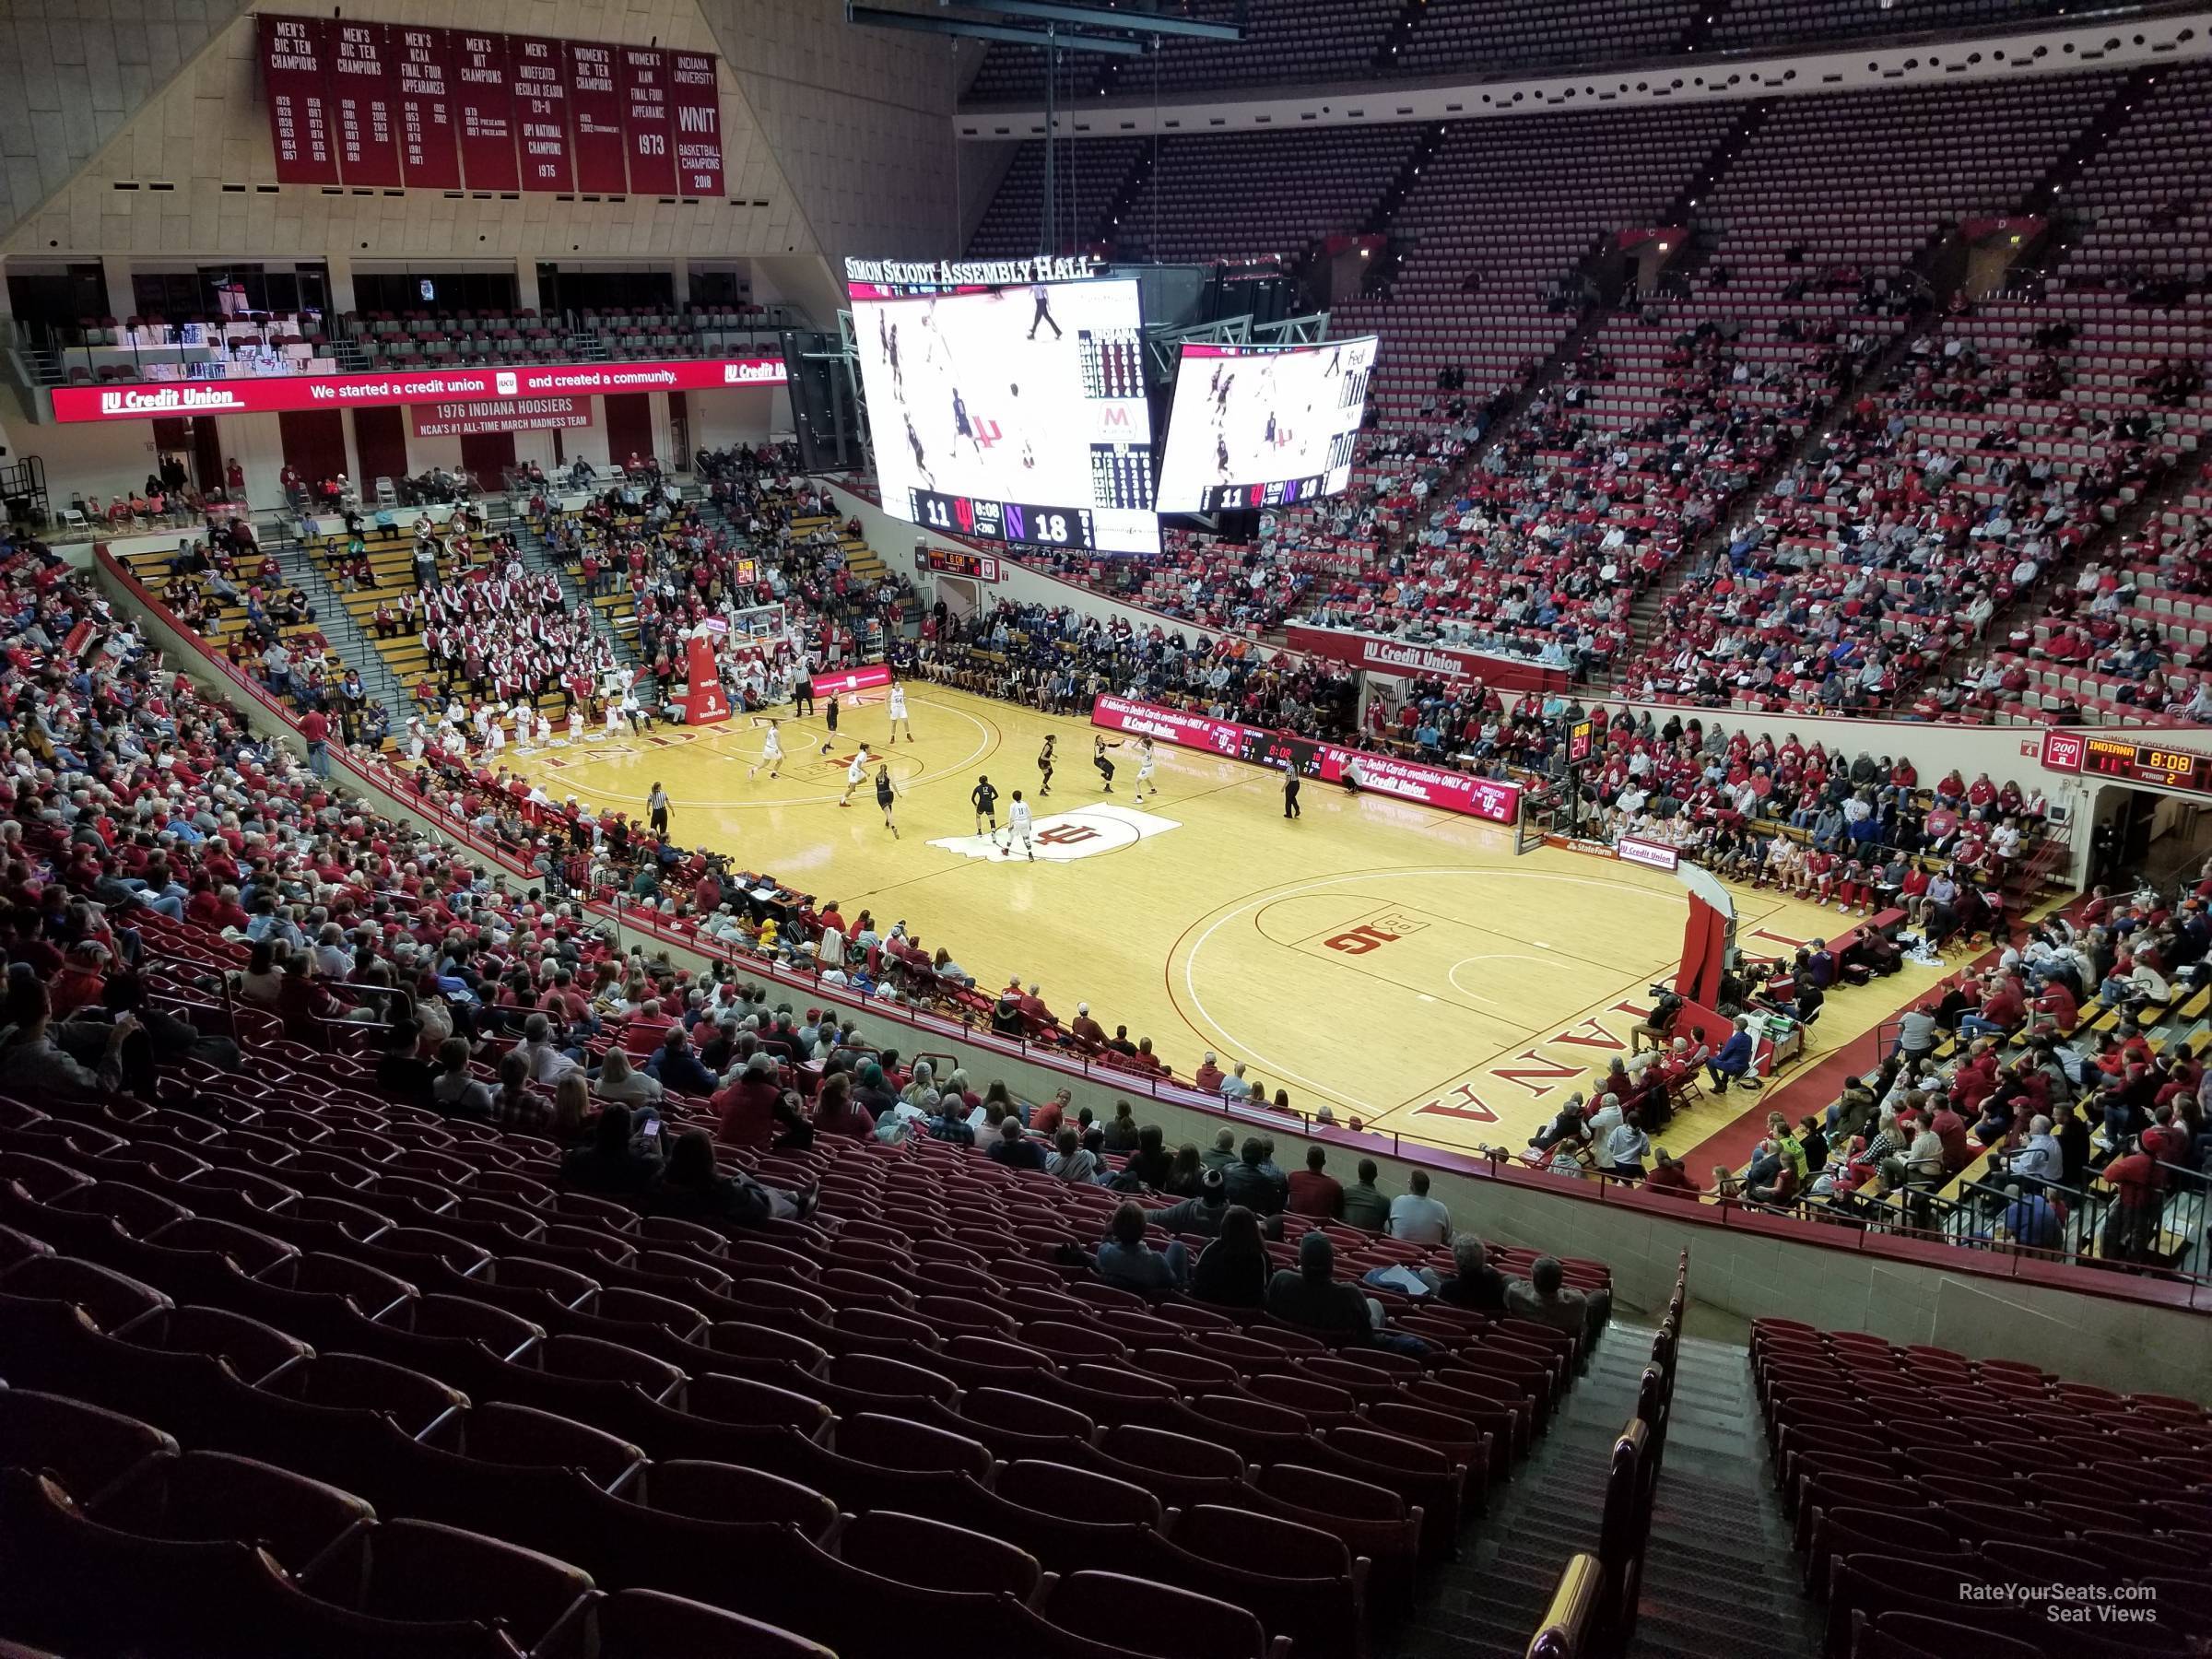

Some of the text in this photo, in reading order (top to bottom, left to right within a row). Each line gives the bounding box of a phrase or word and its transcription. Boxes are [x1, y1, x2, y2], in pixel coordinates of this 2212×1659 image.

[276, 22, 305, 38] MEN'S
[343, 28, 371, 42] MEN'S
[274, 38, 312, 54] BIG TEN
[406, 32, 432, 48] MEN'S
[465, 37, 492, 53] MEN'S
[340, 42, 376, 60] BIG TEN
[410, 48, 429, 63] NCAA
[524, 42, 547, 57] MEN'S
[574, 47, 609, 63] WOMEN'S
[271, 54, 317, 71] CHAMPIONS
[337, 58, 382, 76] CHAMPIONS
[473, 53, 487, 67] NIT
[627, 52, 661, 66] WOMEN'S
[677, 56, 709, 71] INDIANA
[401, 63, 442, 79] FINAL FOUR
[461, 67, 502, 84] CHAMPIONS
[520, 65, 556, 80] UNDEFEATED
[578, 62, 609, 77] BIG TEN
[674, 70, 714, 85] UNIVERSITY
[402, 78, 445, 95] APPEARANCES
[515, 82, 563, 99] REGULAR SEASON
[575, 76, 613, 91] CHAMPIONS
[630, 88, 664, 101] FINAL FOUR
[678, 106, 716, 134] WNIT
[535, 124, 562, 138] NATIONAL
[528, 141, 561, 156] CHAMPIONS
[639, 134, 665, 155] 1973
[678, 144, 721, 157] BASKETBALL
[538, 164, 556, 178] 1975
[682, 157, 720, 171] CHAMPIONS
[845, 255, 1095, 285] SIMON SKJODT ASSEMBLY HALL
[528, 369, 677, 388] and created a community.
[724, 364, 737, 379] IU
[739, 362, 773, 378] Credit
[311, 377, 485, 399] We started a credit union
[499, 378, 514, 387] IUCU
[101, 386, 233, 409] IU Credit Union
[436, 397, 572, 419] 1976 INDIANA HOOSIERS
[1105, 407, 1129, 426] M
[420, 416, 587, 436] NCAA'S #1 ALL-TIME MARCH MADNESS TEAM
[1285, 480, 1297, 502] N
[1300, 478, 1318, 499] 18
[1220, 488, 1242, 508] 11
[926, 499, 950, 527] 11
[1006, 505, 1025, 539] N
[1035, 513, 1067, 542] 18
[738, 570, 752, 583] 24
[1364, 641, 1462, 672] IU Credit Union
[1100, 699, 1107, 708] IU
[1106, 700, 1130, 714] Athletics
[1131, 705, 1146, 716] Debit
[1145, 709, 1161, 720] Cards
[1160, 712, 1187, 726] available
[1187, 717, 1204, 729] ONLY
[1203, 722, 1211, 732] at
[1122, 716, 1176, 736] IU Credit Union
[1243, 728, 1264, 738] INDIANA
[1574, 723, 1589, 737] 8:08
[1269, 745, 1291, 759] 8:08
[1328, 749, 1337, 761] IU
[1571, 737, 1586, 759] 24
[2026, 744, 2032, 756] 4
[2053, 742, 2076, 754] 200
[2088, 740, 2135, 757] INDIANA
[2150, 751, 2190, 771] 8:08
[1366, 759, 1385, 771] Debit
[1385, 763, 1407, 776] Cards
[1406, 770, 1441, 783] available
[1441, 775, 1463, 789] ONLY
[1461, 781, 1471, 792] at
[1370, 772, 1427, 795] Credit Union
[2141, 771, 2165, 782] PERIOD
[2167, 773, 2175, 784] 2
[1629, 846, 1651, 859] Credit
[1651, 849, 1671, 863] Union
